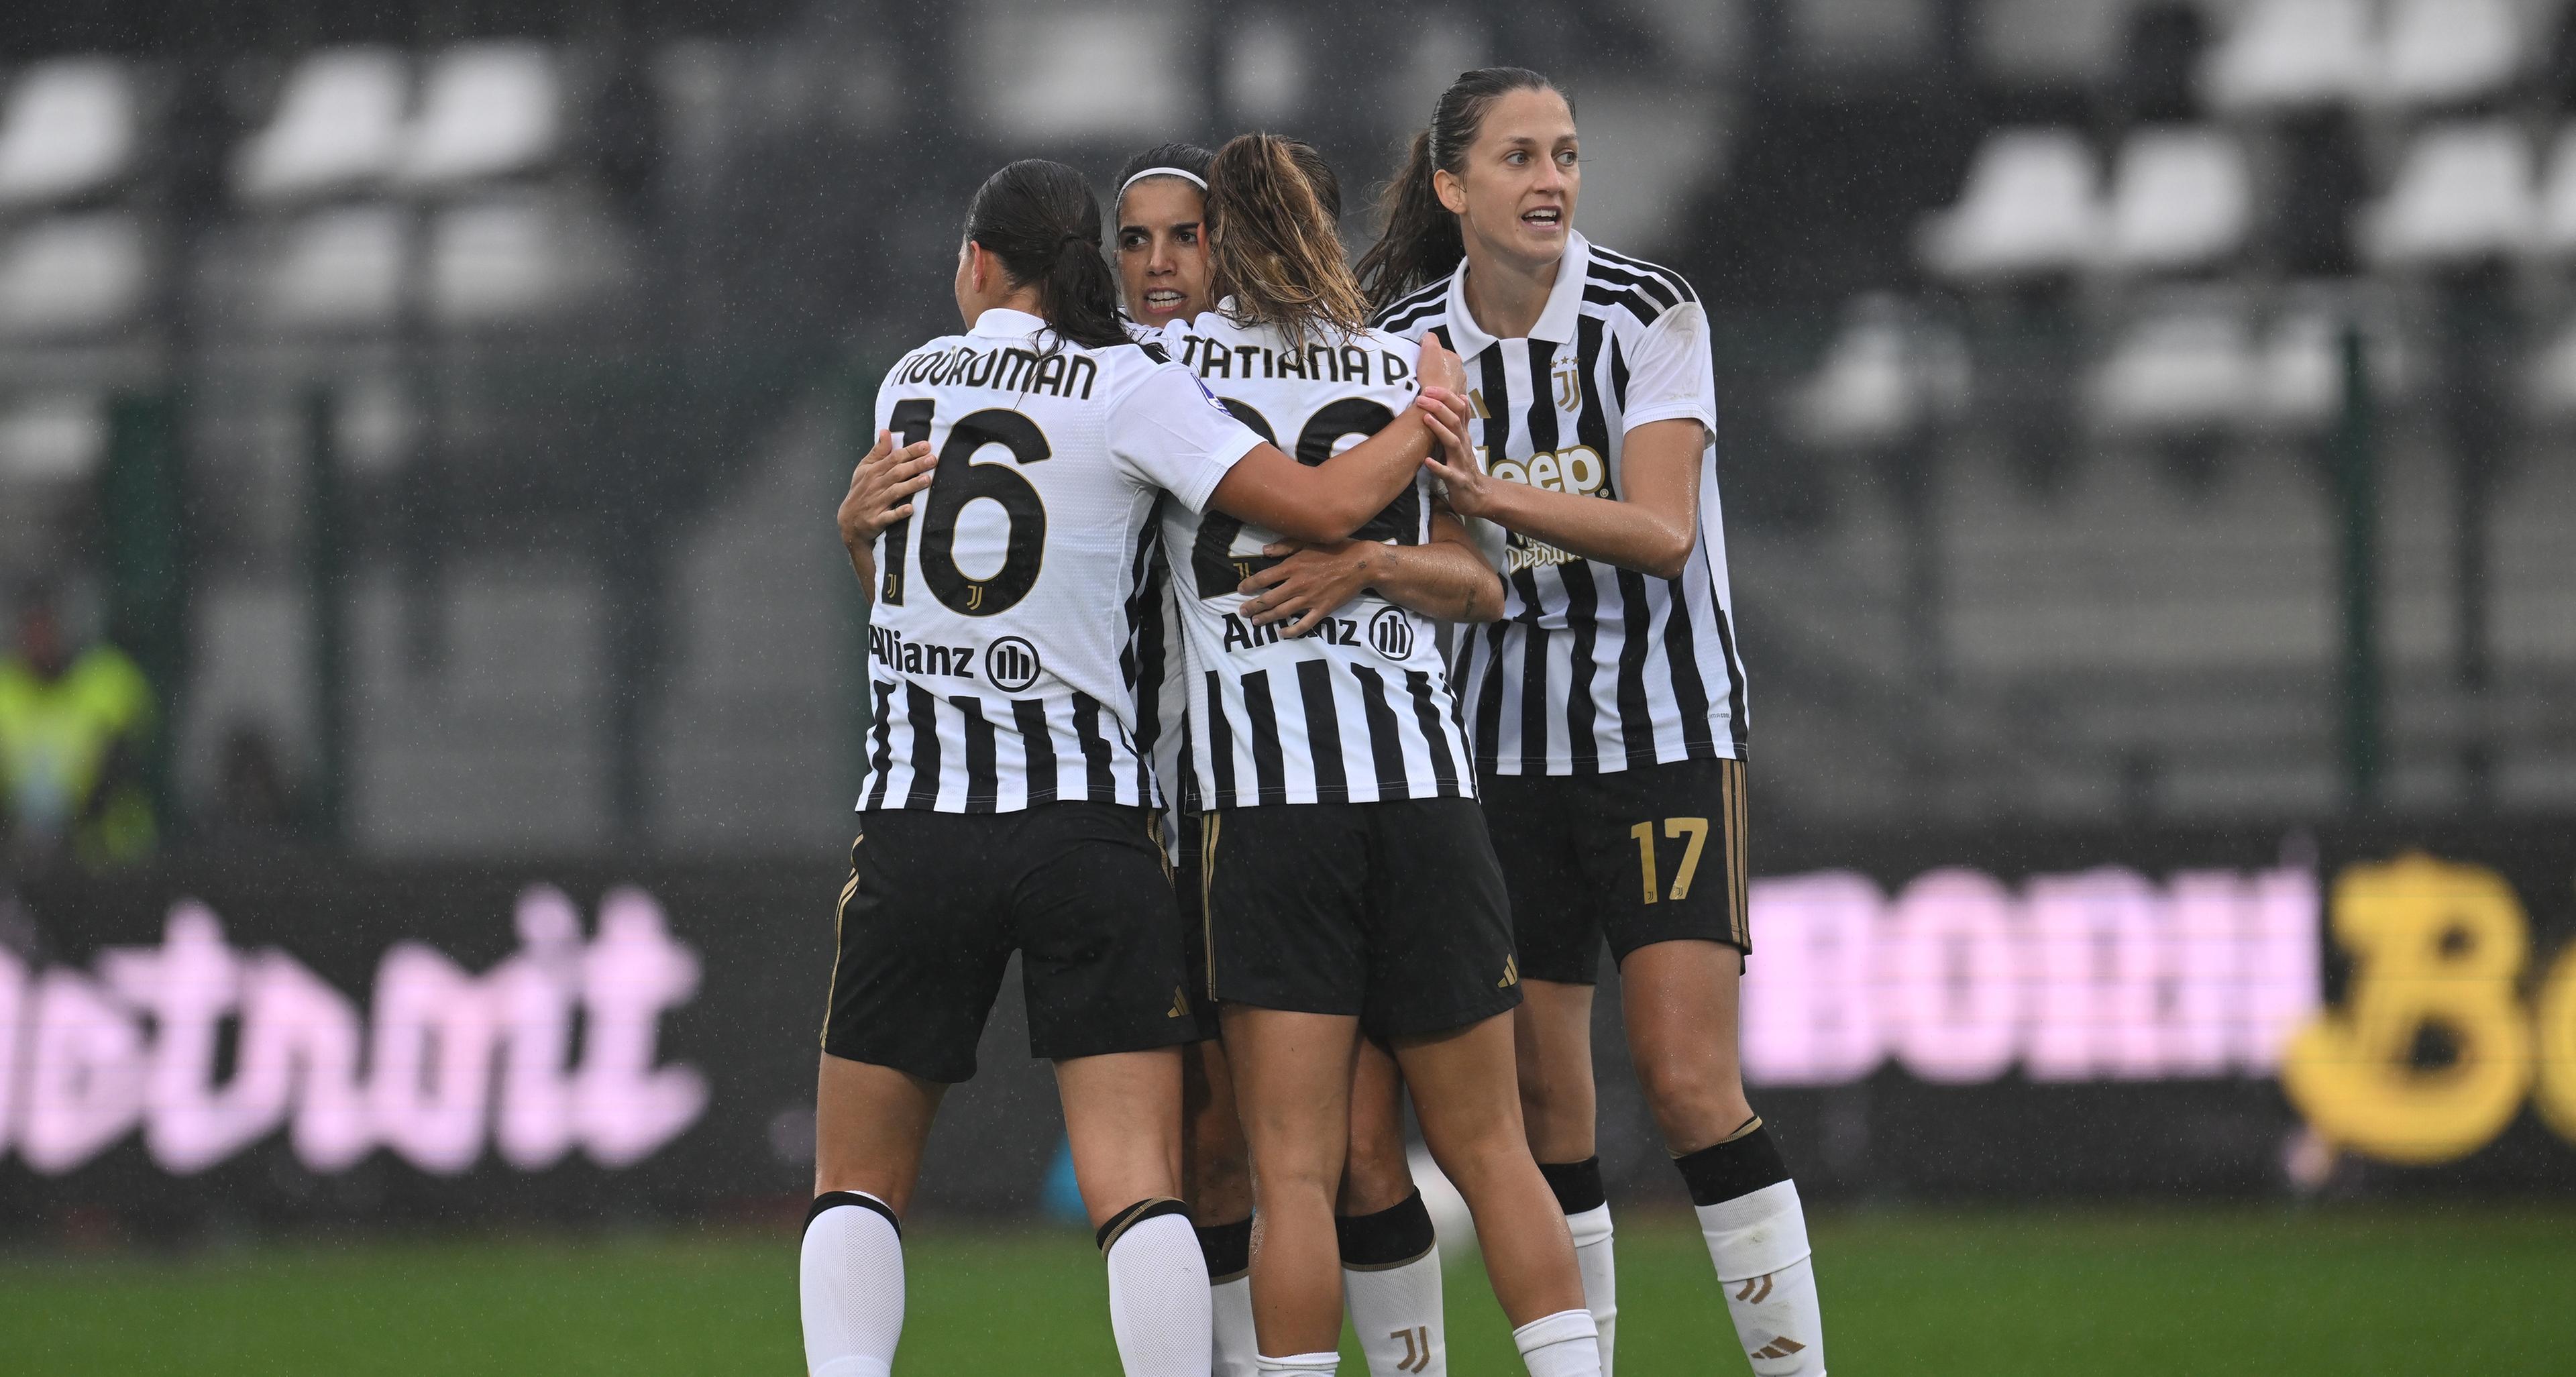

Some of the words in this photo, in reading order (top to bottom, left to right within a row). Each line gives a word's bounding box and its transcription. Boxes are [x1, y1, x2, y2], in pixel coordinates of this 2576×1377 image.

[1182, 334, 1370, 386] TATIANA
[881, 398, 1053, 618] 16
[869, 624, 975, 679] Allianz
[1631, 817, 1709, 905] 17
[0, 882, 710, 1177] etroit
